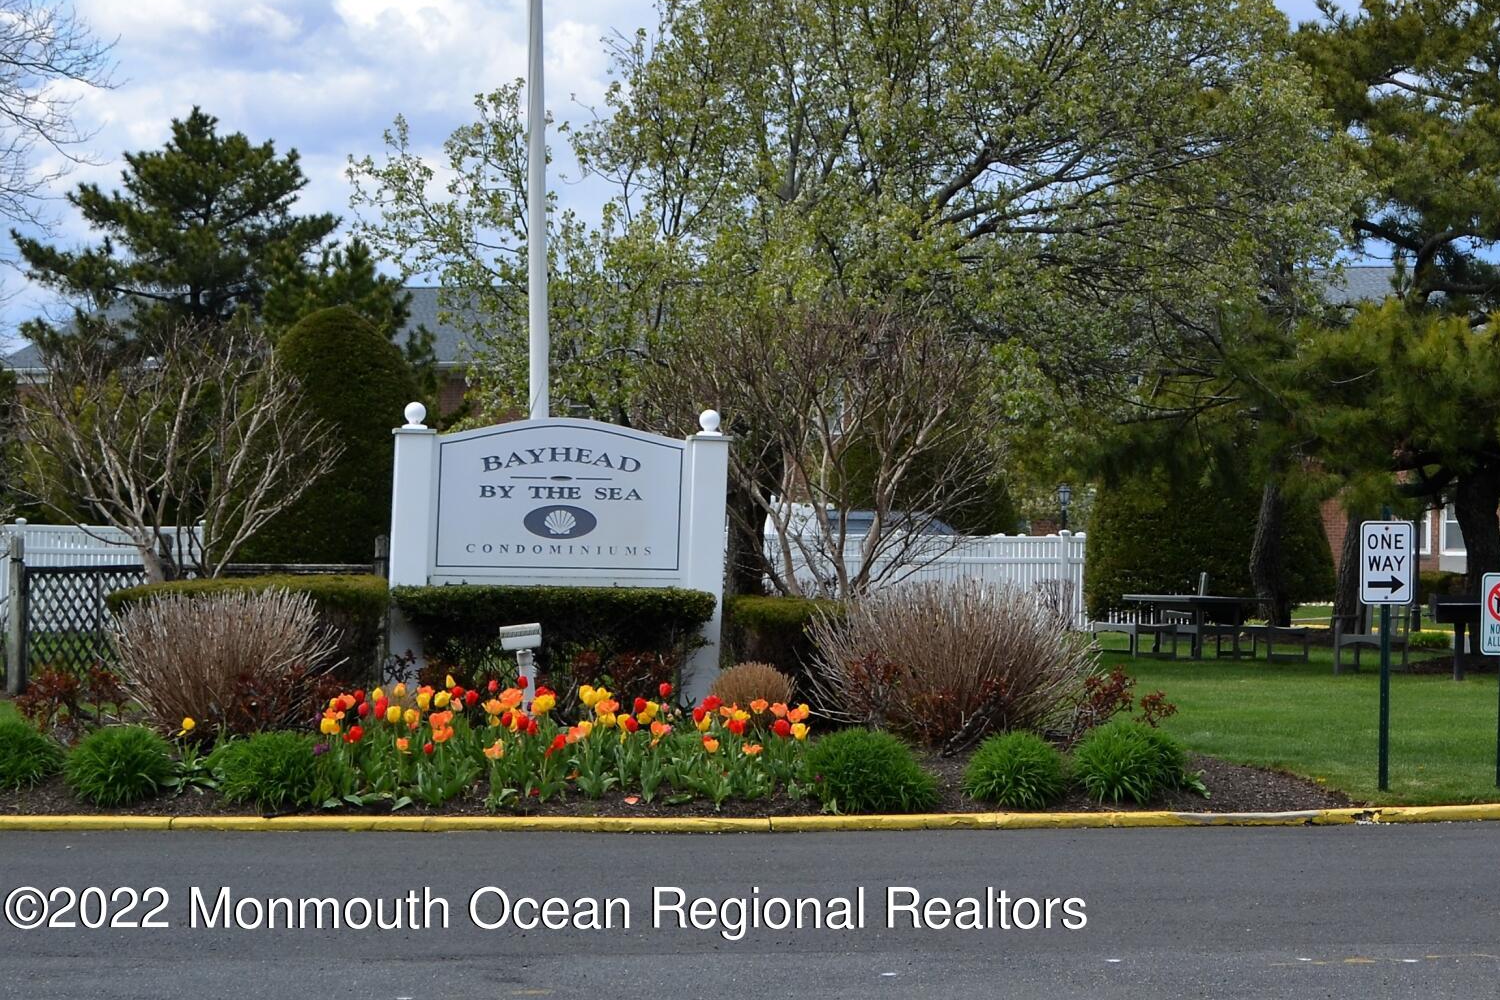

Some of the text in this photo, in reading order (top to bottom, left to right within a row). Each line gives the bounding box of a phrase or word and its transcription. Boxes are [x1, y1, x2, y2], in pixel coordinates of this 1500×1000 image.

[481, 447, 642, 473] BAYHEAD
[479, 485, 643, 501] BY THE SEA
[466, 543, 652, 556] CONDOMINIUMS
[1367, 533, 1404, 550] ONE
[1368, 555, 1405, 572] WAY
[1490, 623, 1500, 635] NO
